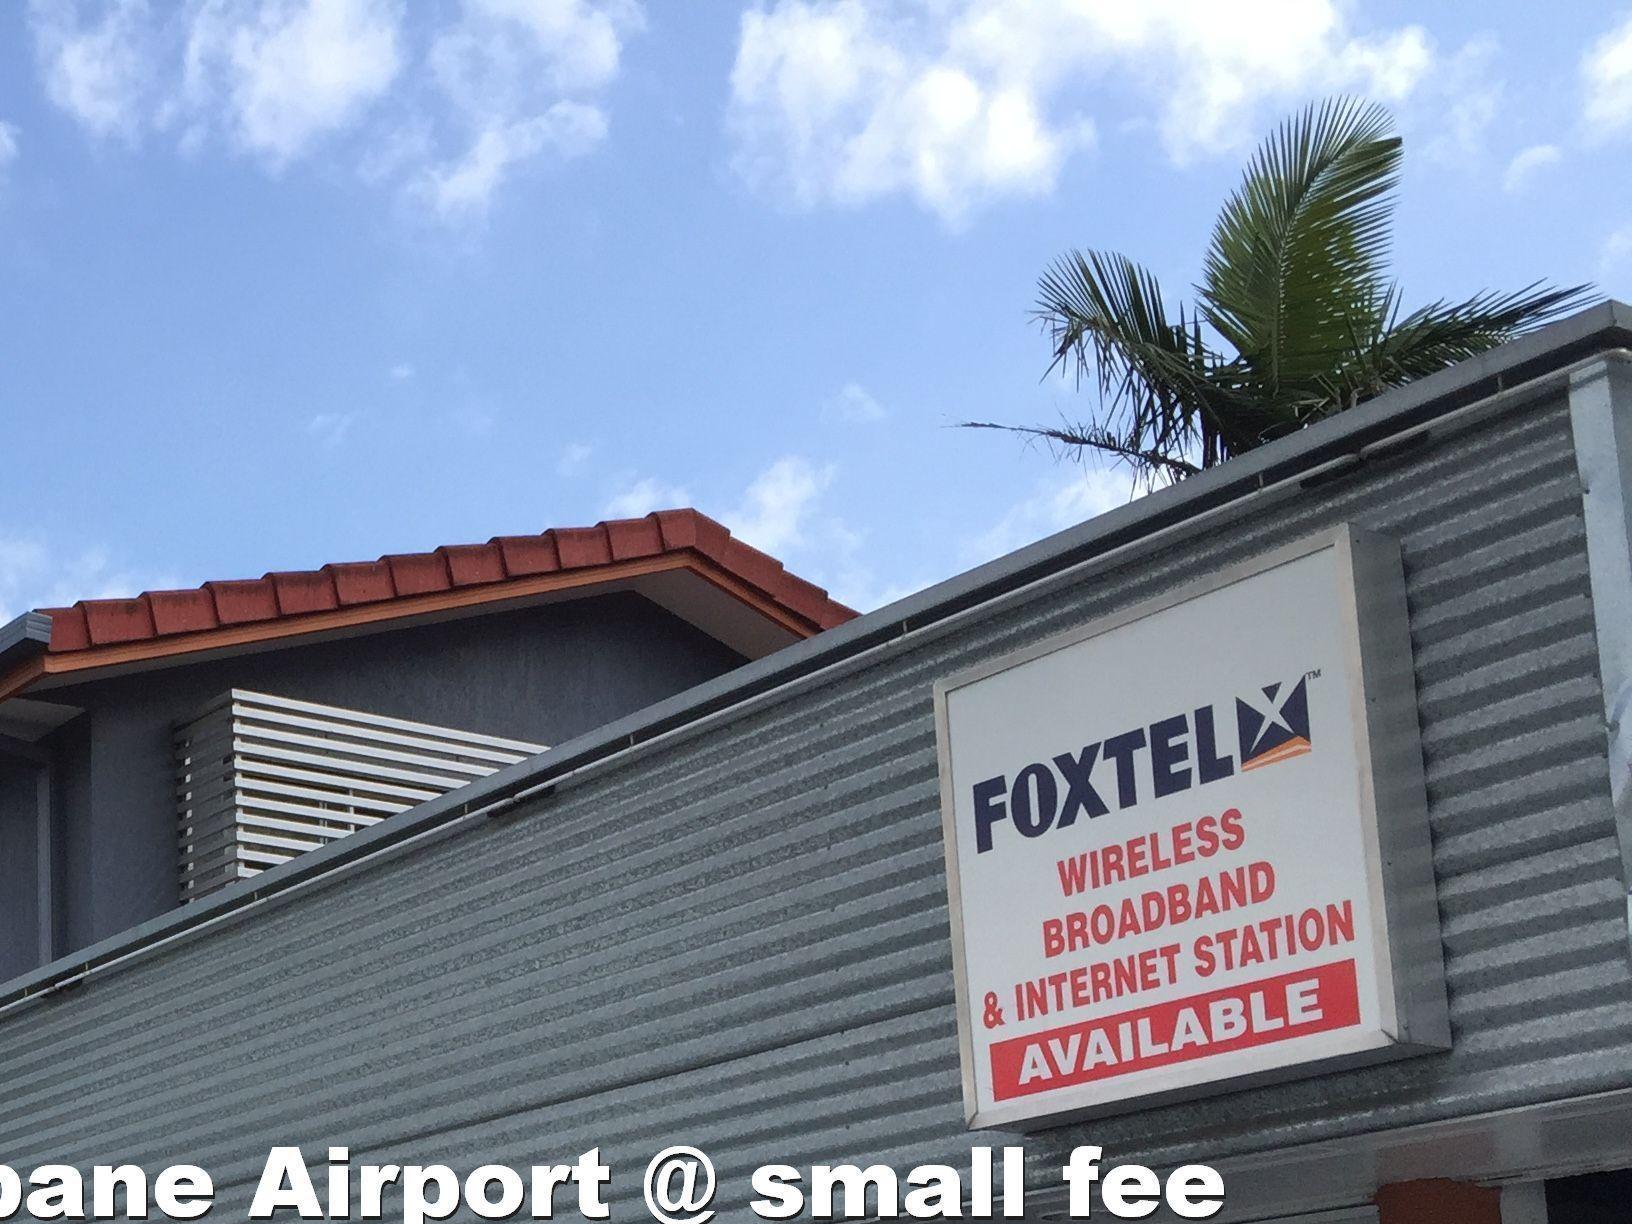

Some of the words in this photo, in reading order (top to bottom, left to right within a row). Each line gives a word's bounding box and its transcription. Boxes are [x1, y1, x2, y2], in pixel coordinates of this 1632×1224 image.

[972, 704, 1235, 855] FOXTEL
[1055, 808, 1246, 898] WIRELESS
[981, 990, 1007, 1030] &
[1014, 942, 1182, 1022] INTERNET
[1192, 899, 1356, 978] STATION
[1041, 860, 1277, 959] BROADBAND
[1017, 976, 1325, 1087] AVAILABLE
